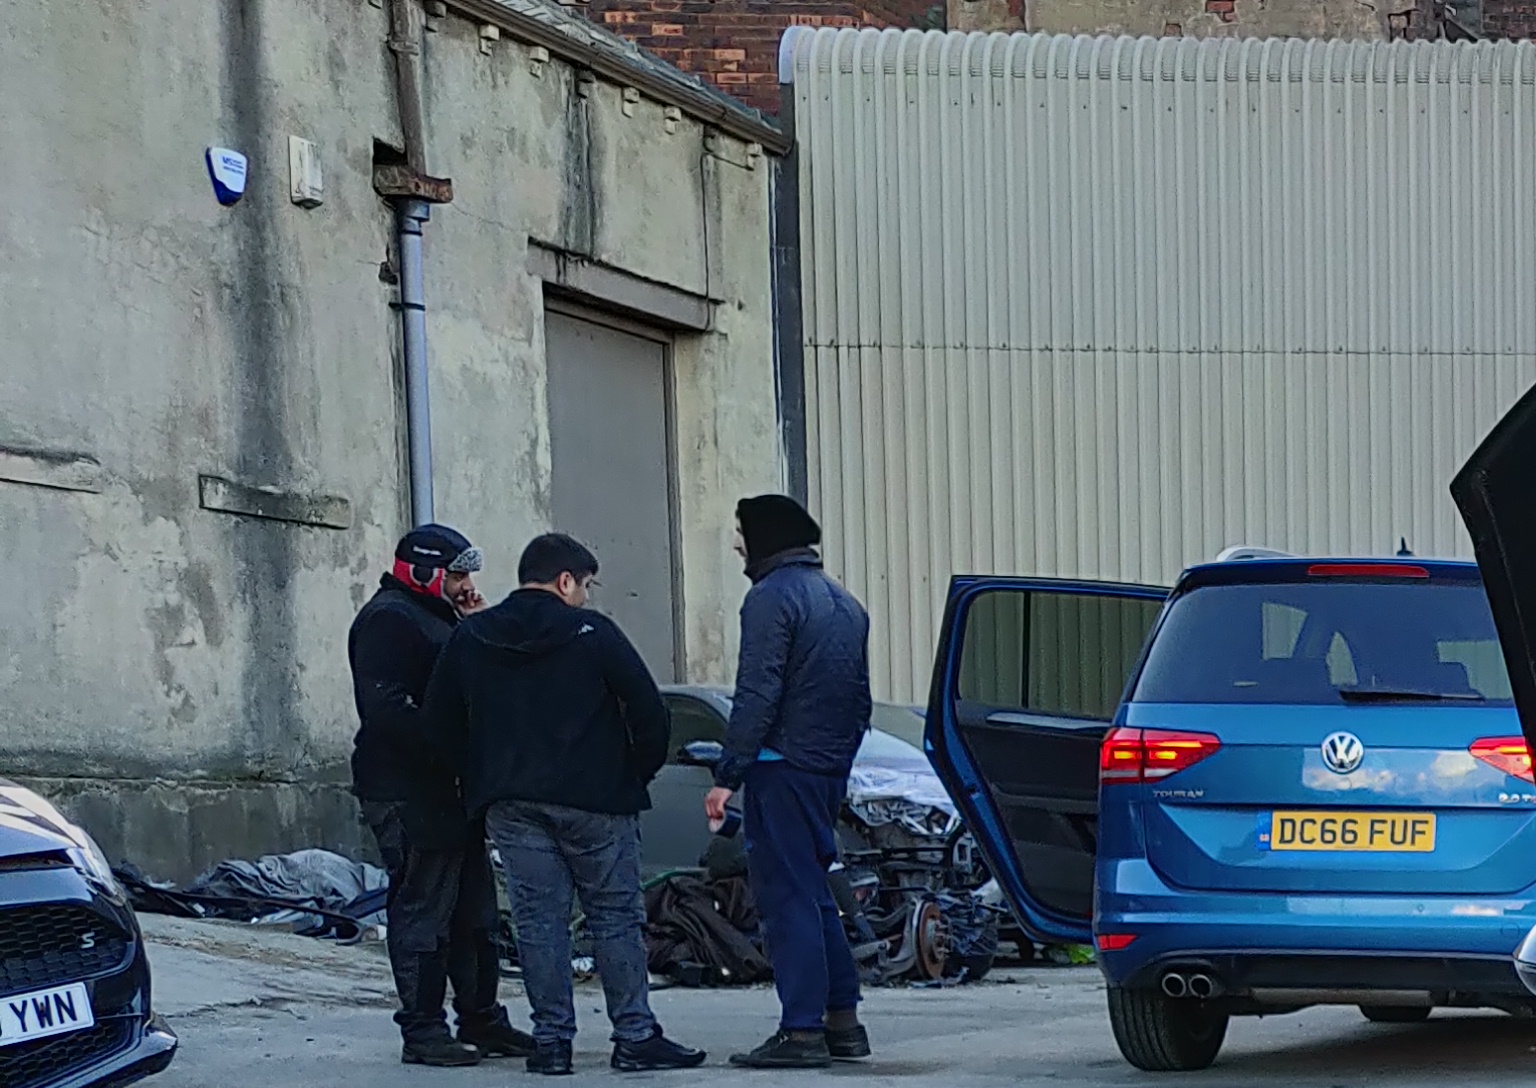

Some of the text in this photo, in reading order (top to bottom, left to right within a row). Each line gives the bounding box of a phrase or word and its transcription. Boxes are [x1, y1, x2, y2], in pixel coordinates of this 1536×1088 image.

[1278, 818, 1430, 846] DC66 FUF
[9, 990, 79, 1033] YWN
